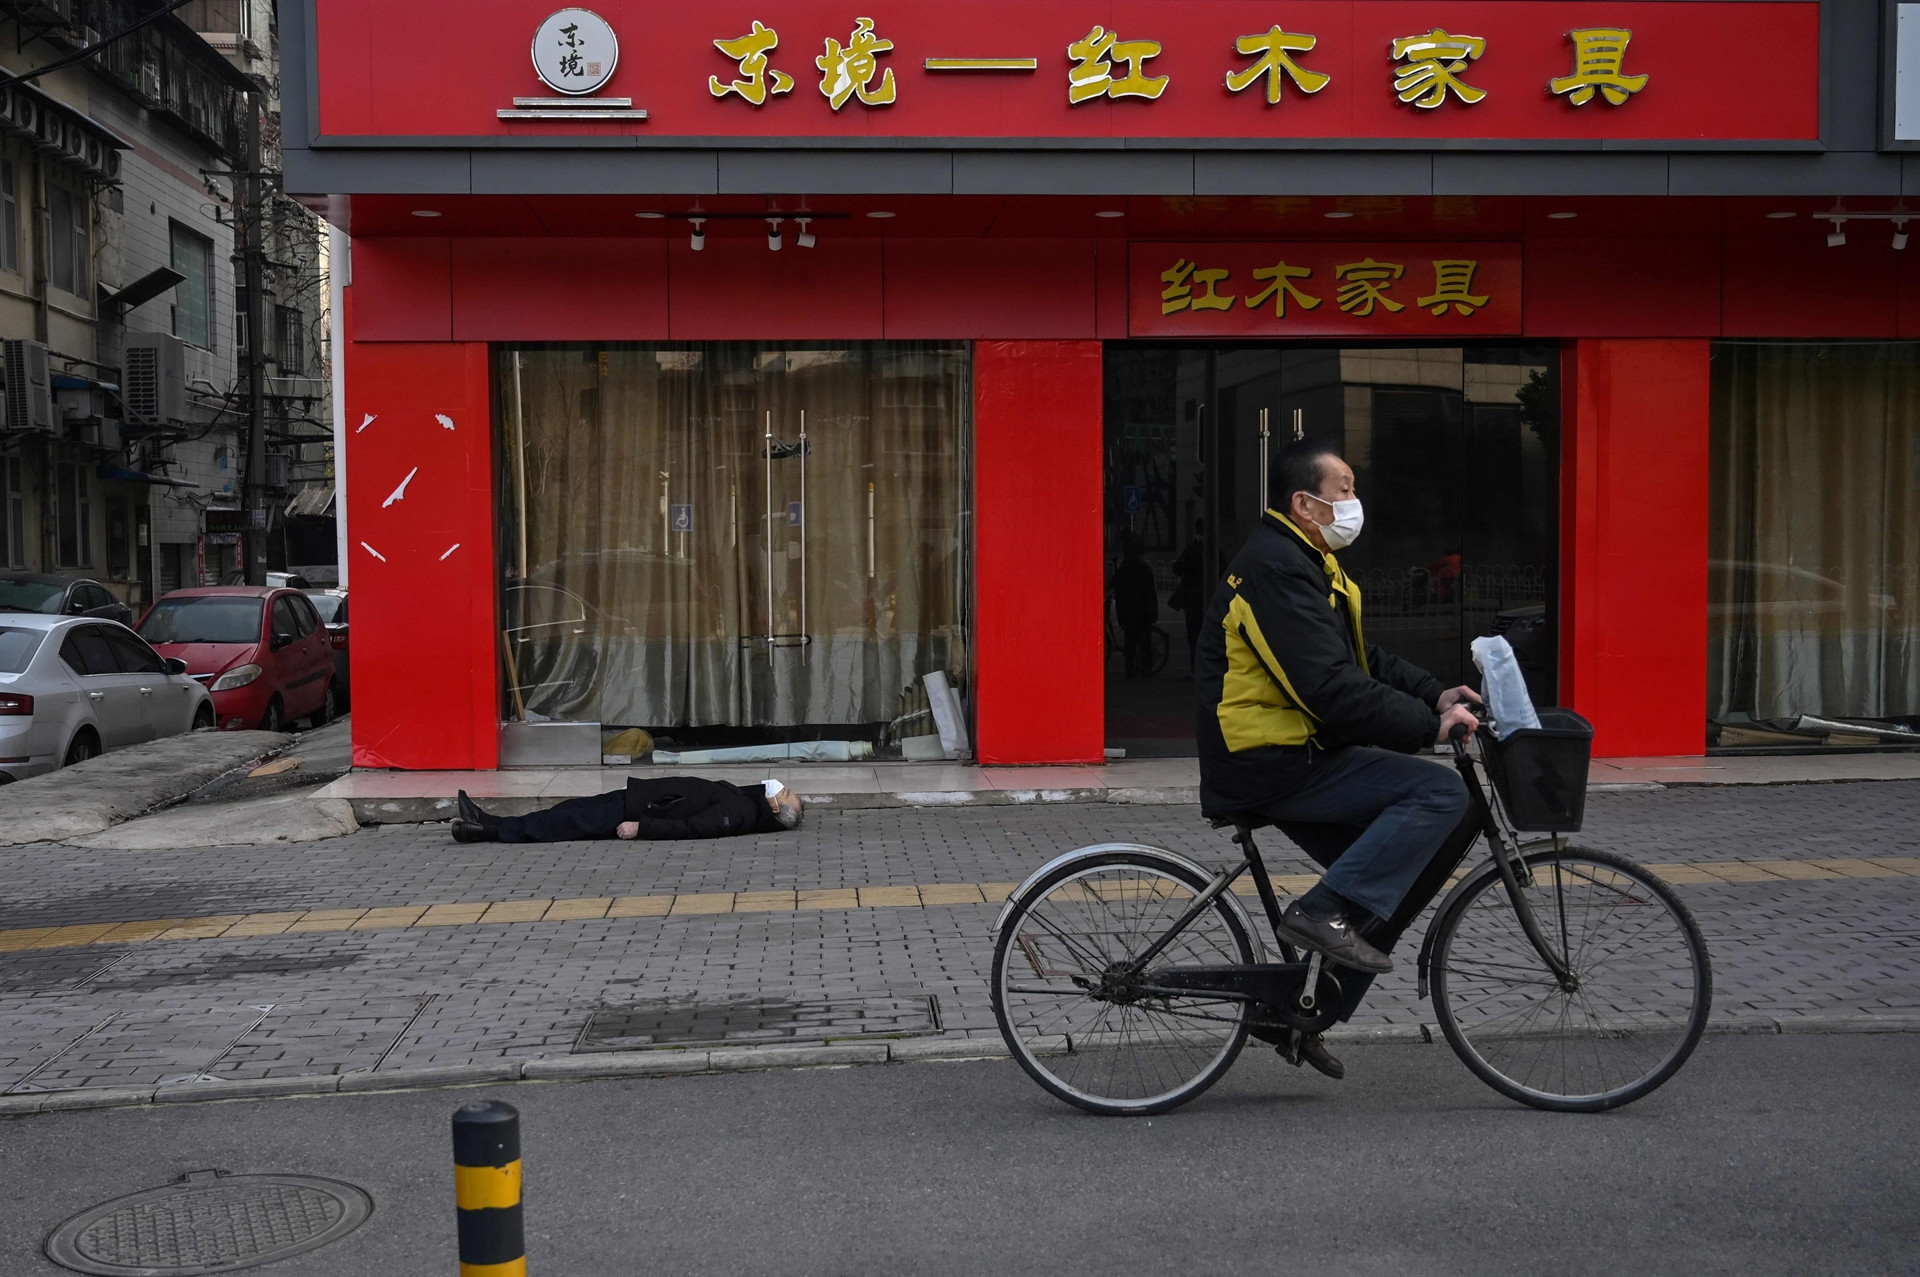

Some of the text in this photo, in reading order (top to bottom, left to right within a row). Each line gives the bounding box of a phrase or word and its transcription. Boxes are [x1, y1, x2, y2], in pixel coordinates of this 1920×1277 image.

[558, 22, 585, 77] 东境
[1160, 258, 1490, 317] 红木家具
